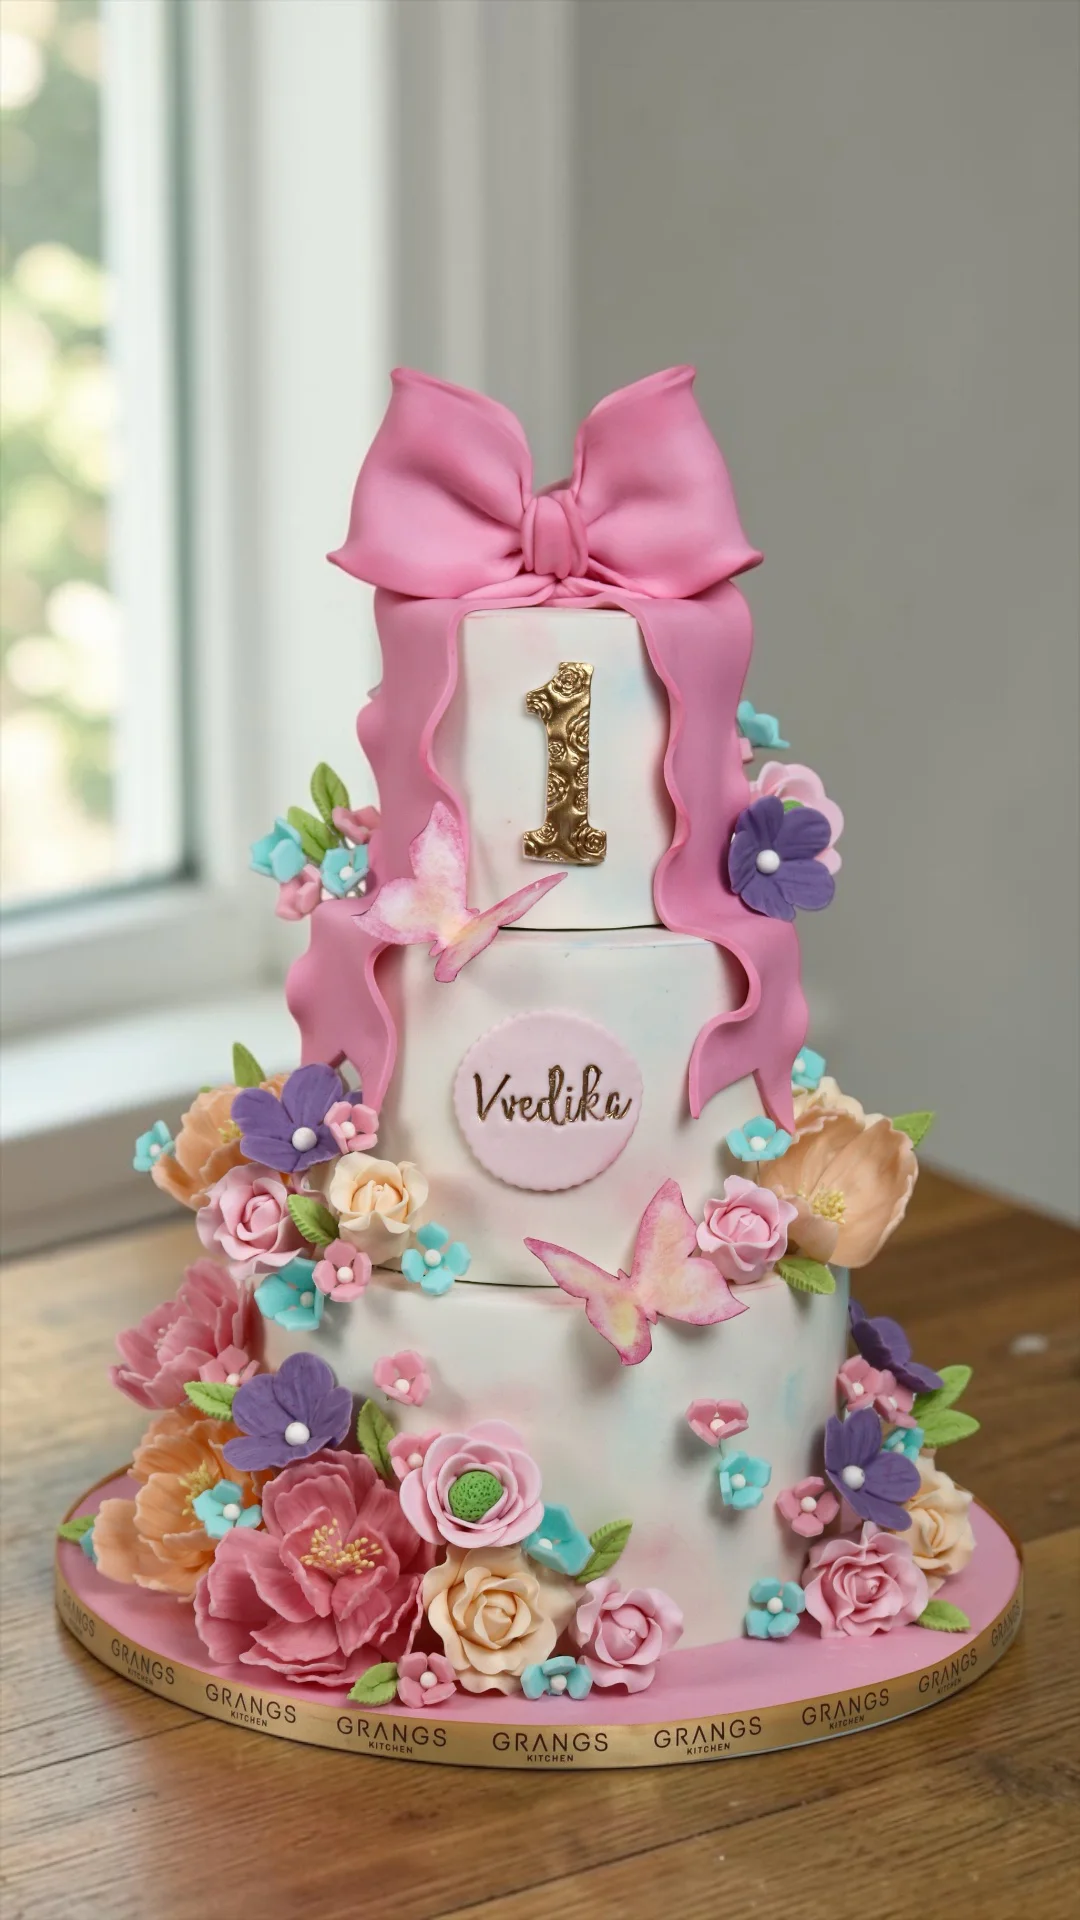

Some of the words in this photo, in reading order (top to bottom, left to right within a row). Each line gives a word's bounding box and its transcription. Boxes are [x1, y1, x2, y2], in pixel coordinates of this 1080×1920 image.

[524, 662, 607, 865] 1
[111, 1638, 175, 1685] GRANGS
[918, 1648, 977, 1693] GRANGS
[205, 1683, 296, 1724] GRANGS
[230, 1710, 268, 1728] KITCHEN
[801, 1688, 889, 1725] GRANGS
[336, 1716, 447, 1747] GRANGS
[654, 1716, 762, 1748] GRANGS
[829, 1714, 865, 1730] KITCHEN
[368, 1740, 413, 1754] KITCHEN
[492, 1732, 608, 1752] GRANGS
[686, 1742, 731, 1755] KITCHEN
[527, 1754, 574, 1763] KITCHEN
